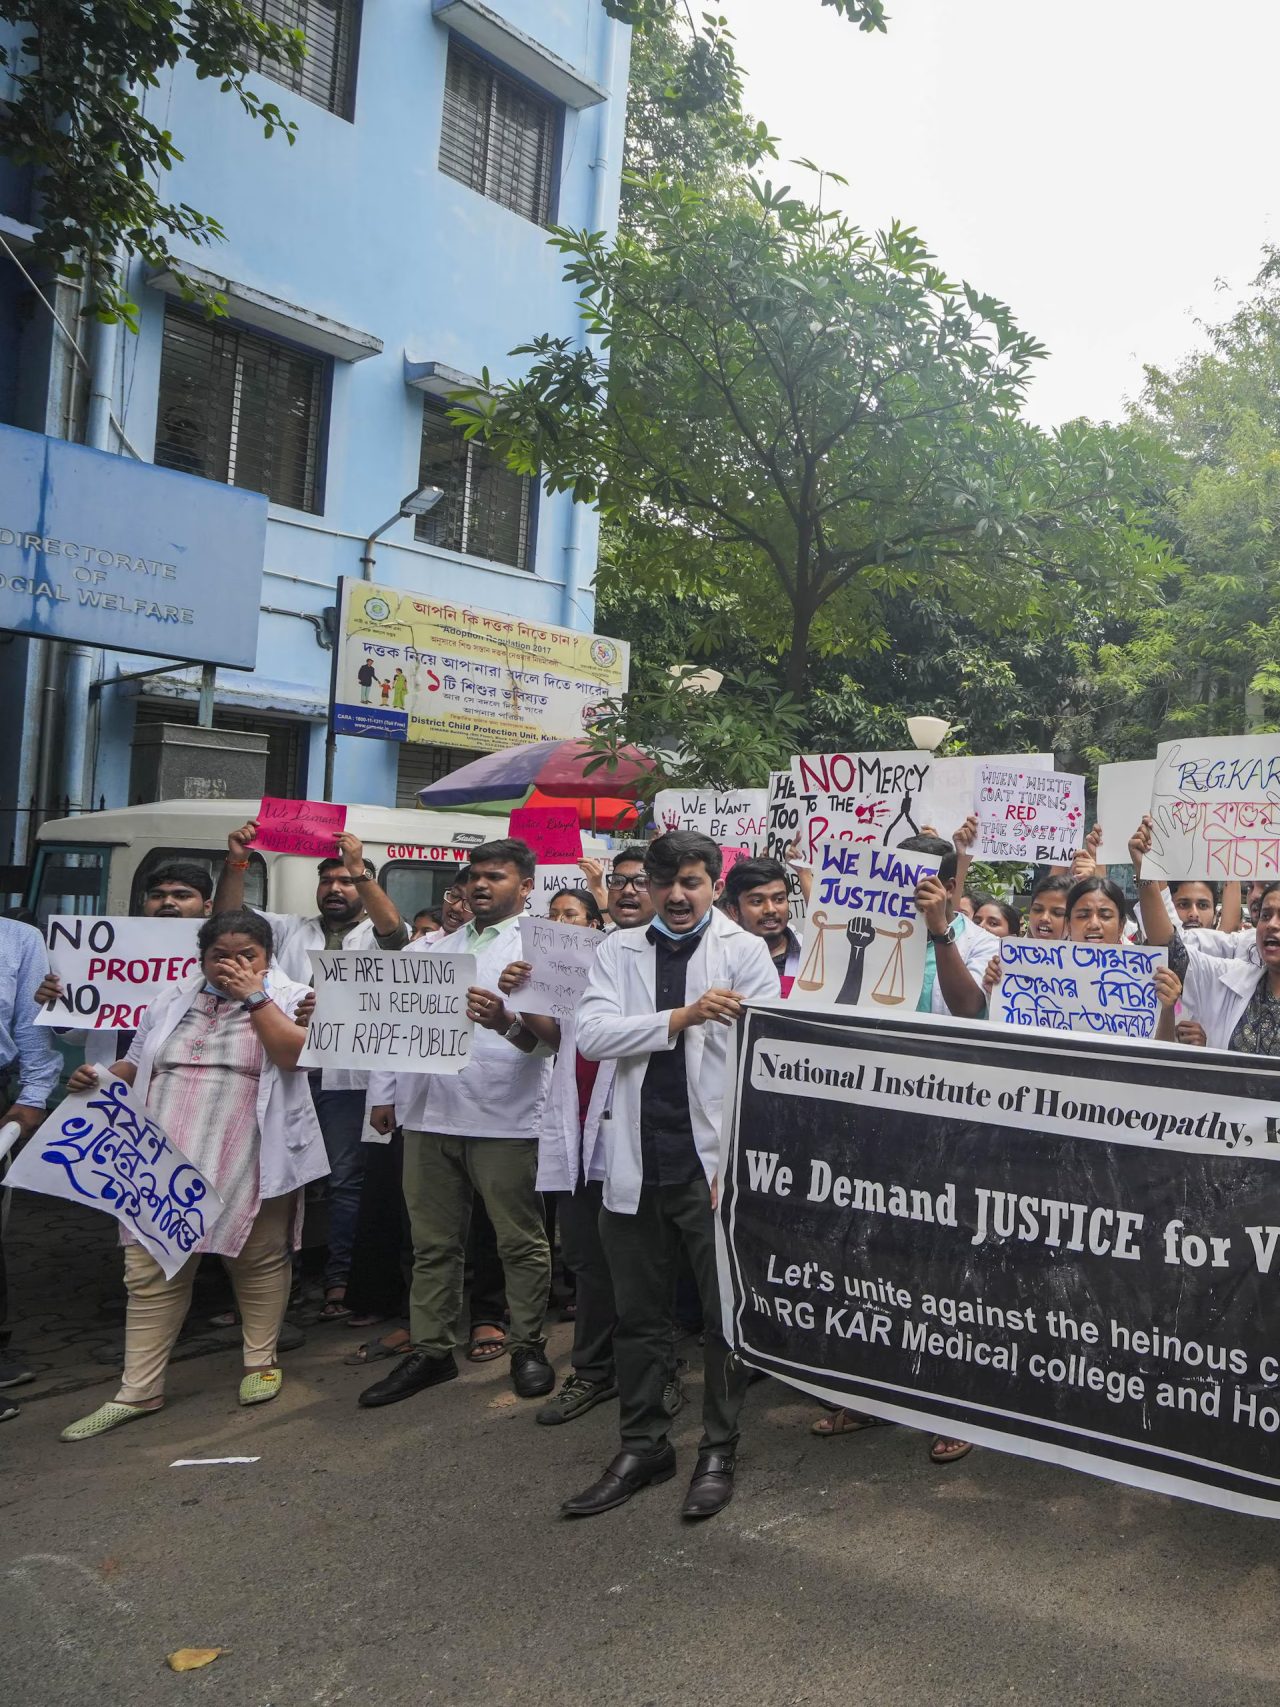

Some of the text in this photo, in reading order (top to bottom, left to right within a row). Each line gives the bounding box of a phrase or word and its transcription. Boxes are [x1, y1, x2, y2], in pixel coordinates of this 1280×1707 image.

[0, 528, 177, 580] DIRECTORATE
[72, 566, 107, 585] OF
[79, 588, 194, 624] WELFARE
[412, 601, 456, 621] আপনি
[462, 608, 479, 626] কি
[482, 615, 514, 633] দত্তক
[517, 622, 547, 640] নিতে
[550, 633, 570, 647] চান
[533, 644, 551, 654] 2017
[362, 641, 400, 659] দত্তক
[404, 646, 437, 667] নিয়ে
[543, 673, 572, 690] দিতে
[575, 681, 609, 697] পারেন
[460, 678, 496, 698] শিশুর
[411, 715, 445, 728] District
[448, 721, 471, 731] Child
[473, 724, 518, 738] Protection
[519, 731, 539, 741] Unit,
[800, 754, 930, 795] NO MERCY
[982, 771, 1072, 794] WHEN WHITE
[265, 802, 289, 819] We
[681, 795, 751, 816] WE WANT
[828, 795, 855, 813] THE
[980, 787, 1067, 811] COAT TURNS
[1005, 804, 1037, 821] RED
[710, 819, 728, 837] BE
[735, 816, 768, 836] SAF
[770, 803, 799, 830] TOO
[981, 822, 1078, 845] THE SOCIETY
[387, 844, 427, 859] GOVT.
[430, 847, 448, 860] OF
[822, 844, 860, 876] WE
[981, 838, 1077, 862] TURNS BLAC
[543, 876, 567, 890] WAS
[819, 878, 917, 919] JUSTICE
[49, 919, 115, 953] NO
[88, 957, 199, 984] PROTEC
[319, 957, 455, 985] WE ARE LIVING
[1000, 940, 1162, 976] অভয়া আমরা
[46, 983, 100, 1015] NO
[359, 991, 459, 1015] IN REPUBLIC
[1001, 969, 1158, 1009] তোমার বিচার
[307, 1021, 468, 1058] NOT RAPE-PUBLIC
[758, 1052, 865, 1090] National
[871, 1066, 991, 1108] Institute
[998, 1085, 1030, 1112] of
[1032, 1087, 1253, 1149] Homoeopathy,
[41, 1117, 147, 1199] খুনের
[168, 1163, 206, 1208] ও
[746, 1149, 793, 1197] We
[807, 1159, 958, 1227] Demand
[972, 1187, 1145, 1260] JUSTICE
[1163, 1219, 1231, 1268] for
[767, 1254, 835, 1293] Let's
[844, 1275, 912, 1309] unite
[922, 1293, 1038, 1334] against
[1047, 1311, 1099, 1344] the
[1111, 1319, 1248, 1374] heinous
[751, 1287, 772, 1317] in
[774, 1297, 815, 1330] RG
[825, 1306, 893, 1346] KAR
[902, 1319, 1018, 1373] Medical
[1029, 1353, 1145, 1404] college
[1156, 1382, 1222, 1418] and
